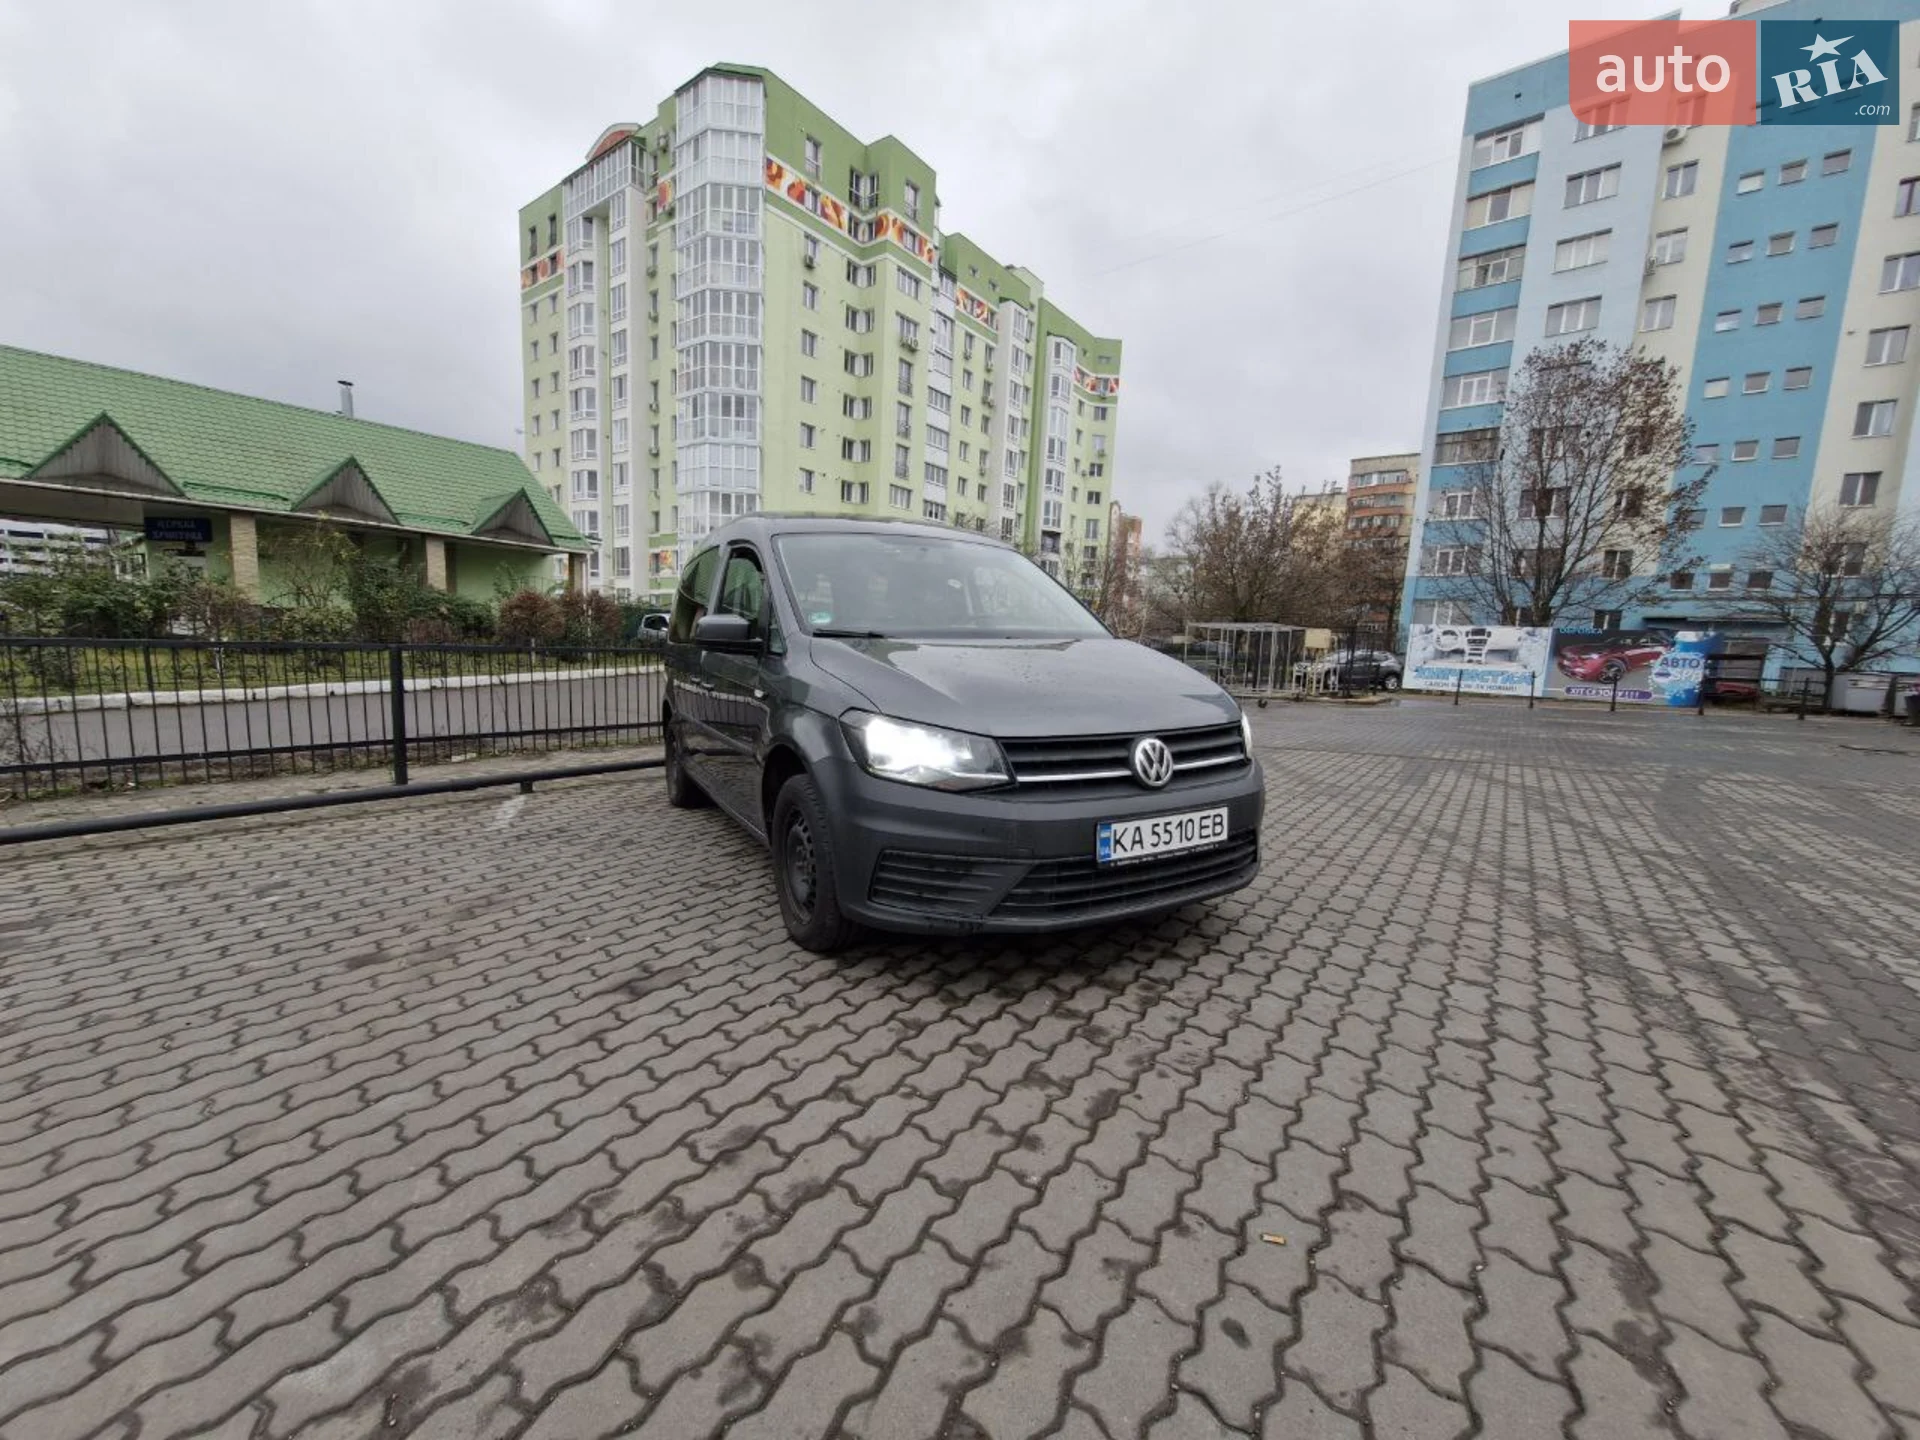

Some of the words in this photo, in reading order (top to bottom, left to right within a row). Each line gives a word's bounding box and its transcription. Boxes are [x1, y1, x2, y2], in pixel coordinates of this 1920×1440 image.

[1659, 658, 1701, 670] АВТО
[1112, 825, 1144, 854] KA
[1150, 817, 1195, 848] 5510
[1199, 812, 1225, 840] EB
